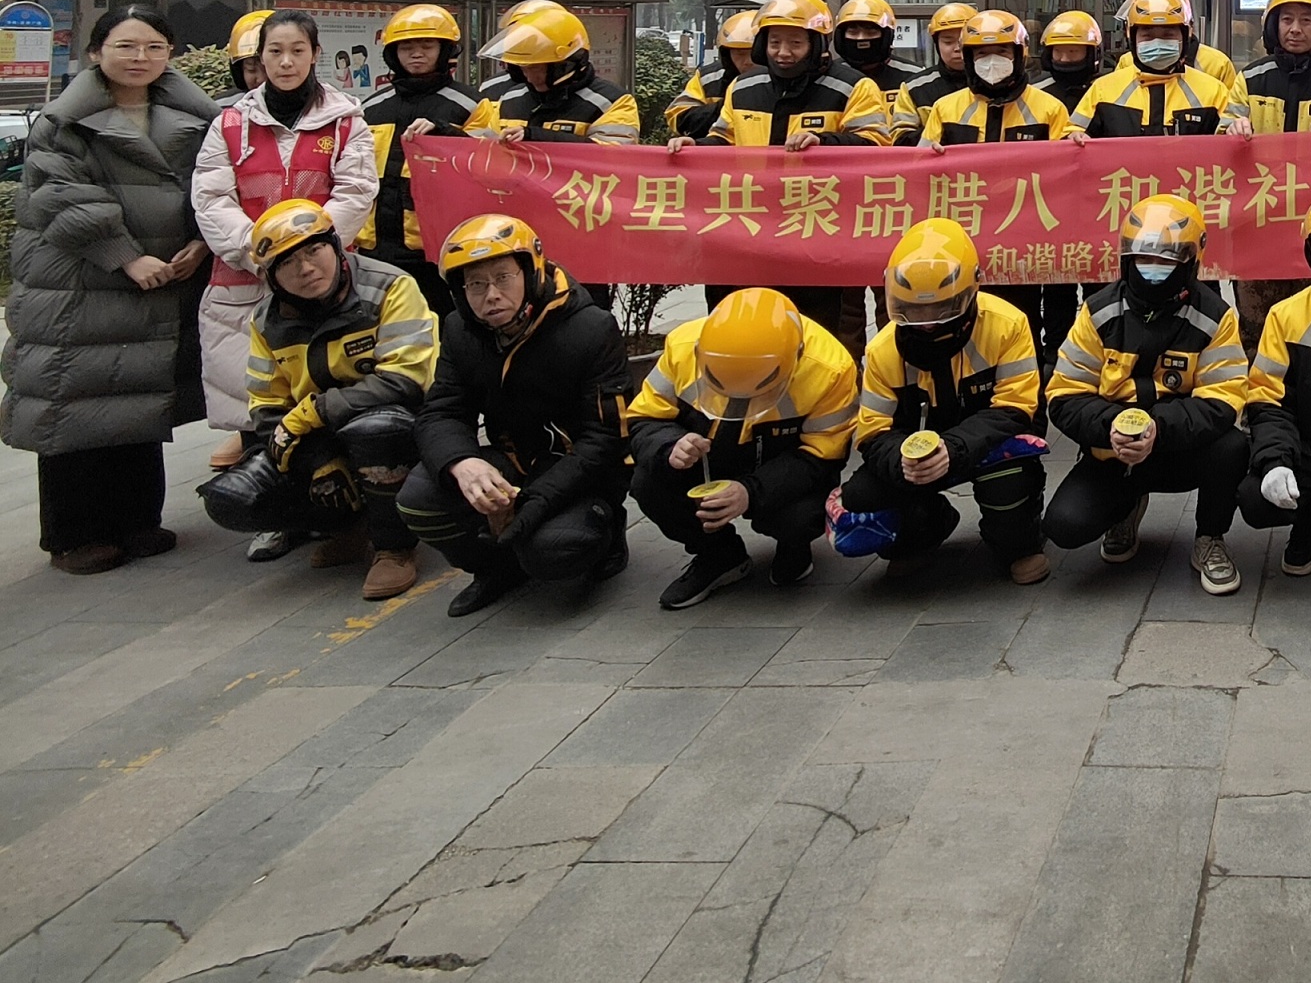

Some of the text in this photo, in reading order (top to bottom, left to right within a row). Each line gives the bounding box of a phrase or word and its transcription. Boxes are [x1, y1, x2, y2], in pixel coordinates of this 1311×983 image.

[553, 171, 1060, 238] 邻里共聚品腊八
